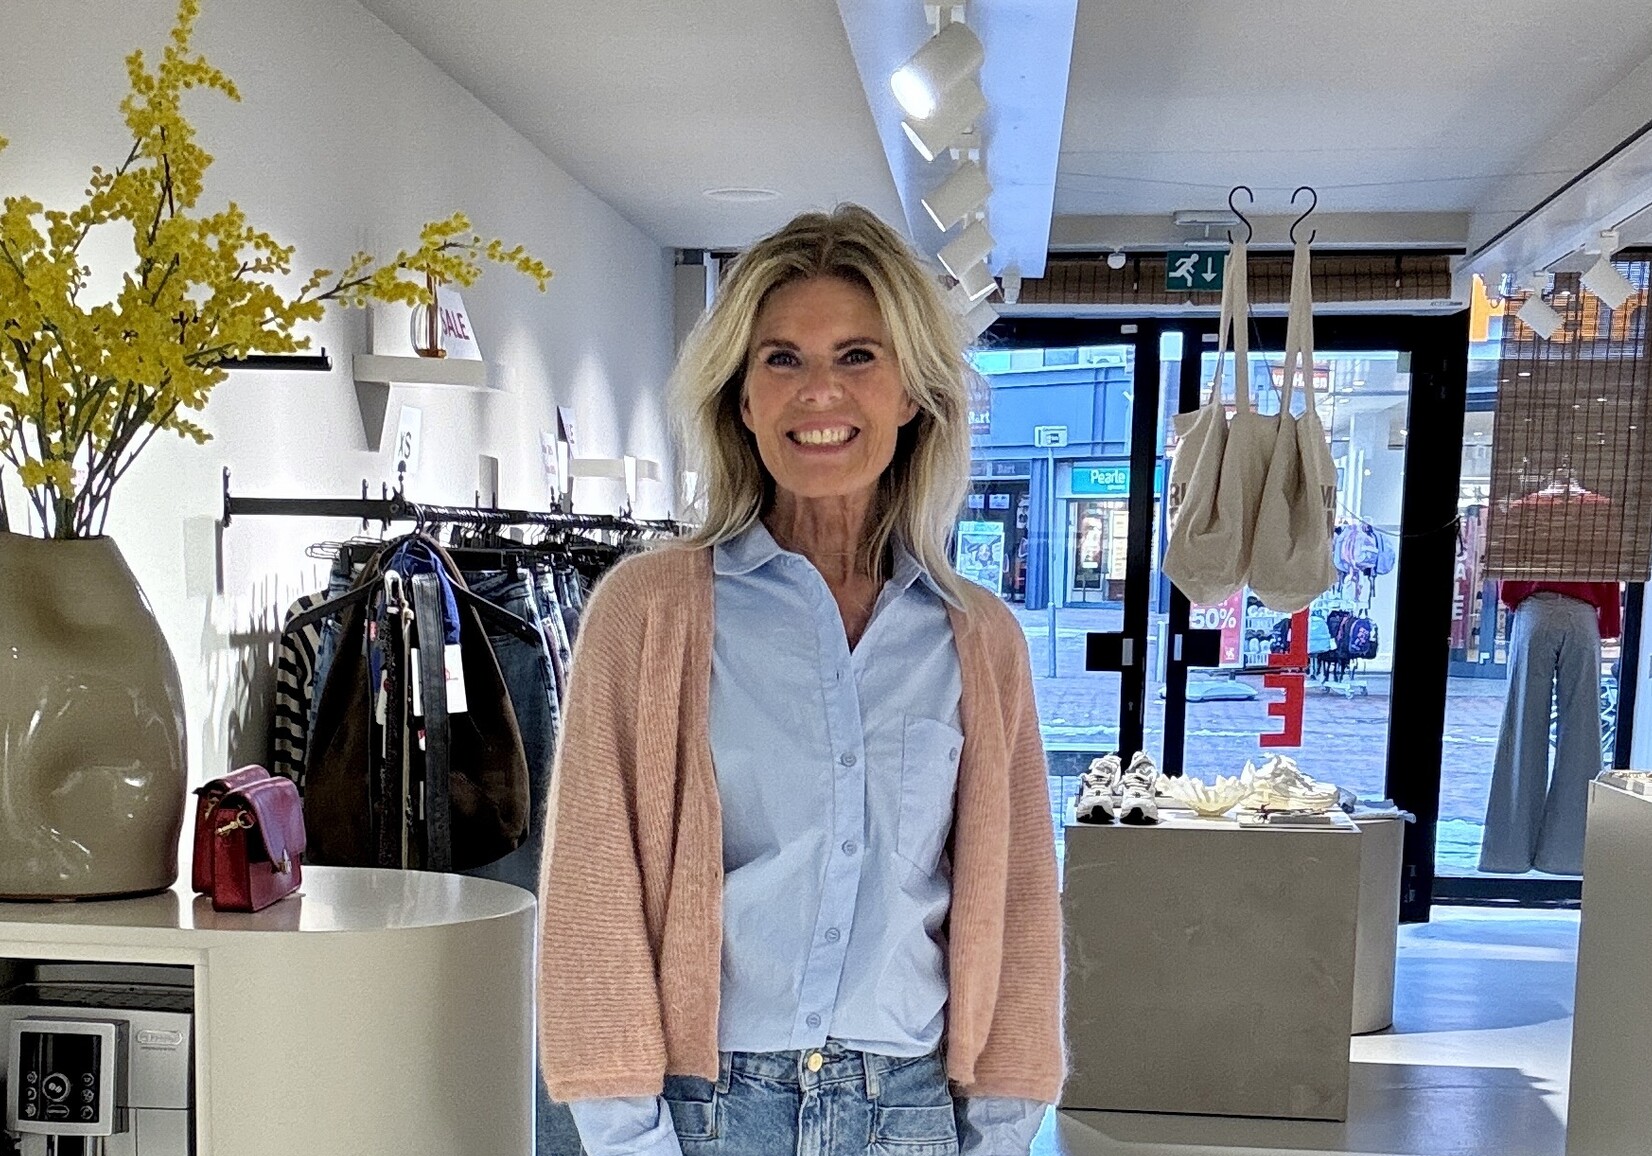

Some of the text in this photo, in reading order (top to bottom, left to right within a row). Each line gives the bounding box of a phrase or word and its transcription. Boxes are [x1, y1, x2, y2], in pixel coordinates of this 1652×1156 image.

[440, 306, 470, 340] SALE
[1090, 468, 1126, 485] Pearle
[1190, 607, 1237, 630] 50%
